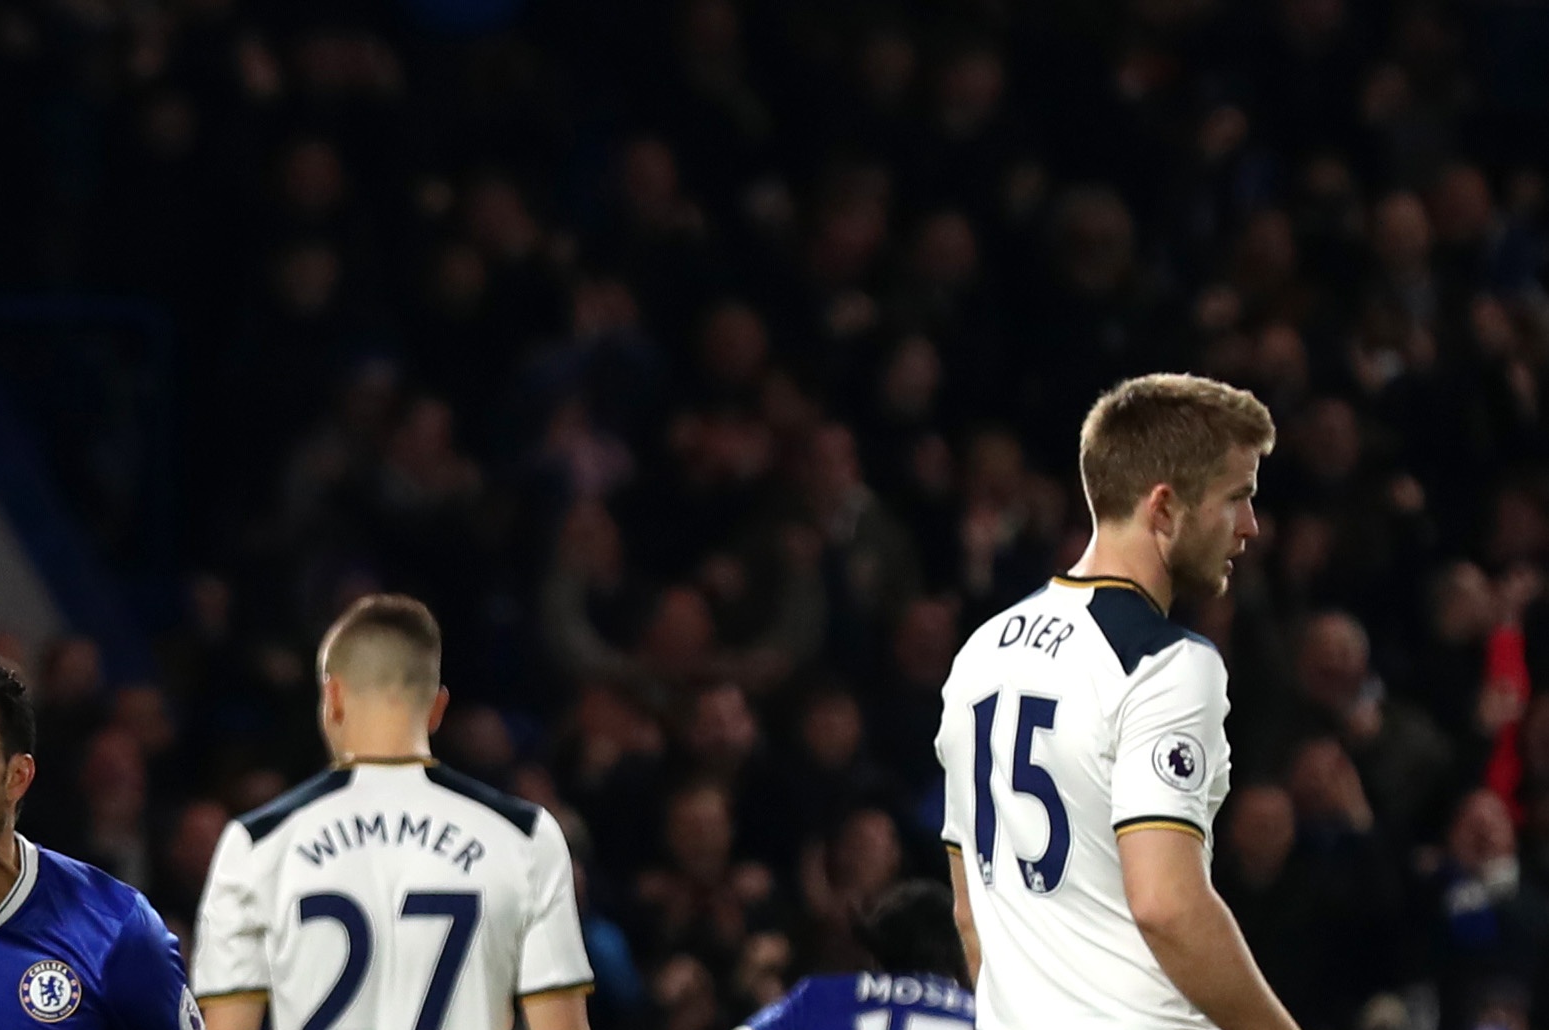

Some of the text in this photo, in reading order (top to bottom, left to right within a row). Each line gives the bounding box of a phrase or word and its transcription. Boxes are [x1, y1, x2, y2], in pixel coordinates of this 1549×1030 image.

[997, 613, 1075, 659] DIER
[968, 686, 1074, 894] 15
[298, 810, 487, 875] WIMMER
